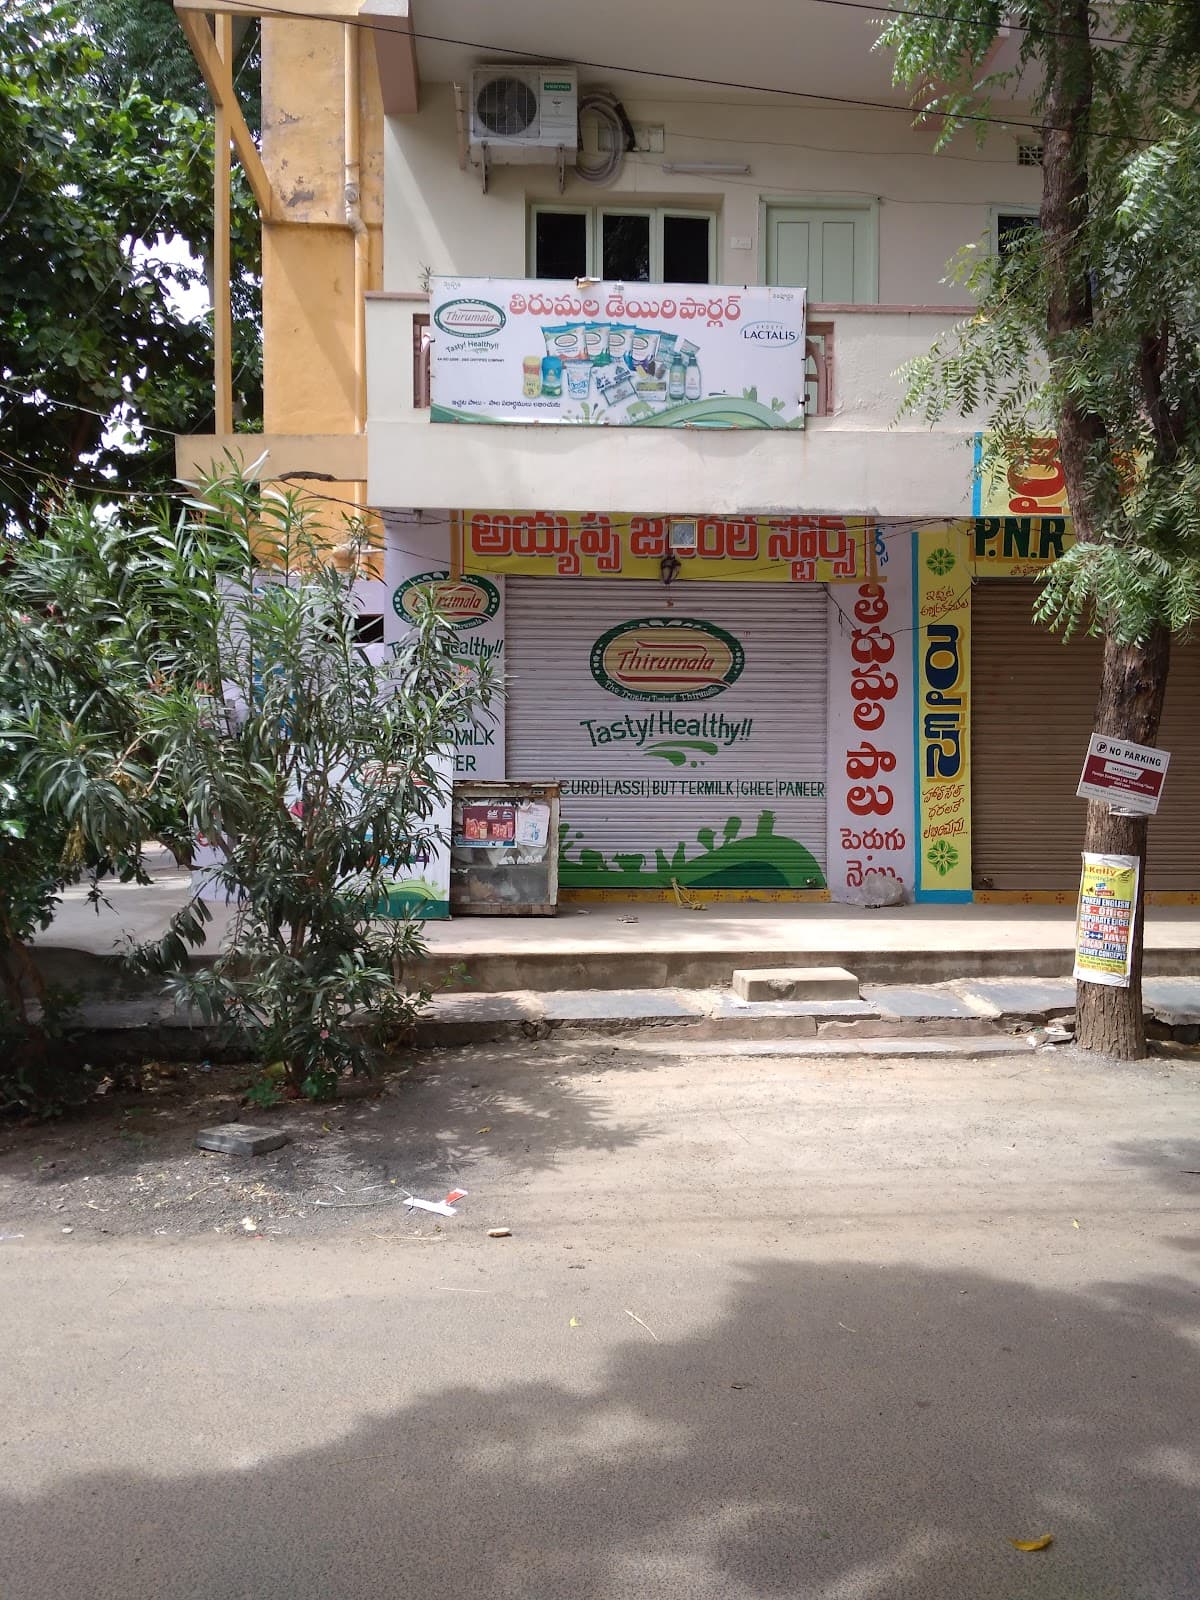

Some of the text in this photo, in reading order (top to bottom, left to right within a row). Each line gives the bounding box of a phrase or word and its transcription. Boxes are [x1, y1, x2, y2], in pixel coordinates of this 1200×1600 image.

[446, 310, 495, 322] Thirumala
[509, 293, 600, 317] తిరుమల
[744, 330, 796, 340] LACTALIS
[618, 647, 715, 671] Thirumala
[579, 710, 753, 747] Tasty! Healthy!!
[1109, 746, 1161, 767] NO PARKING
[840, 828, 906, 851] పెరుగు
